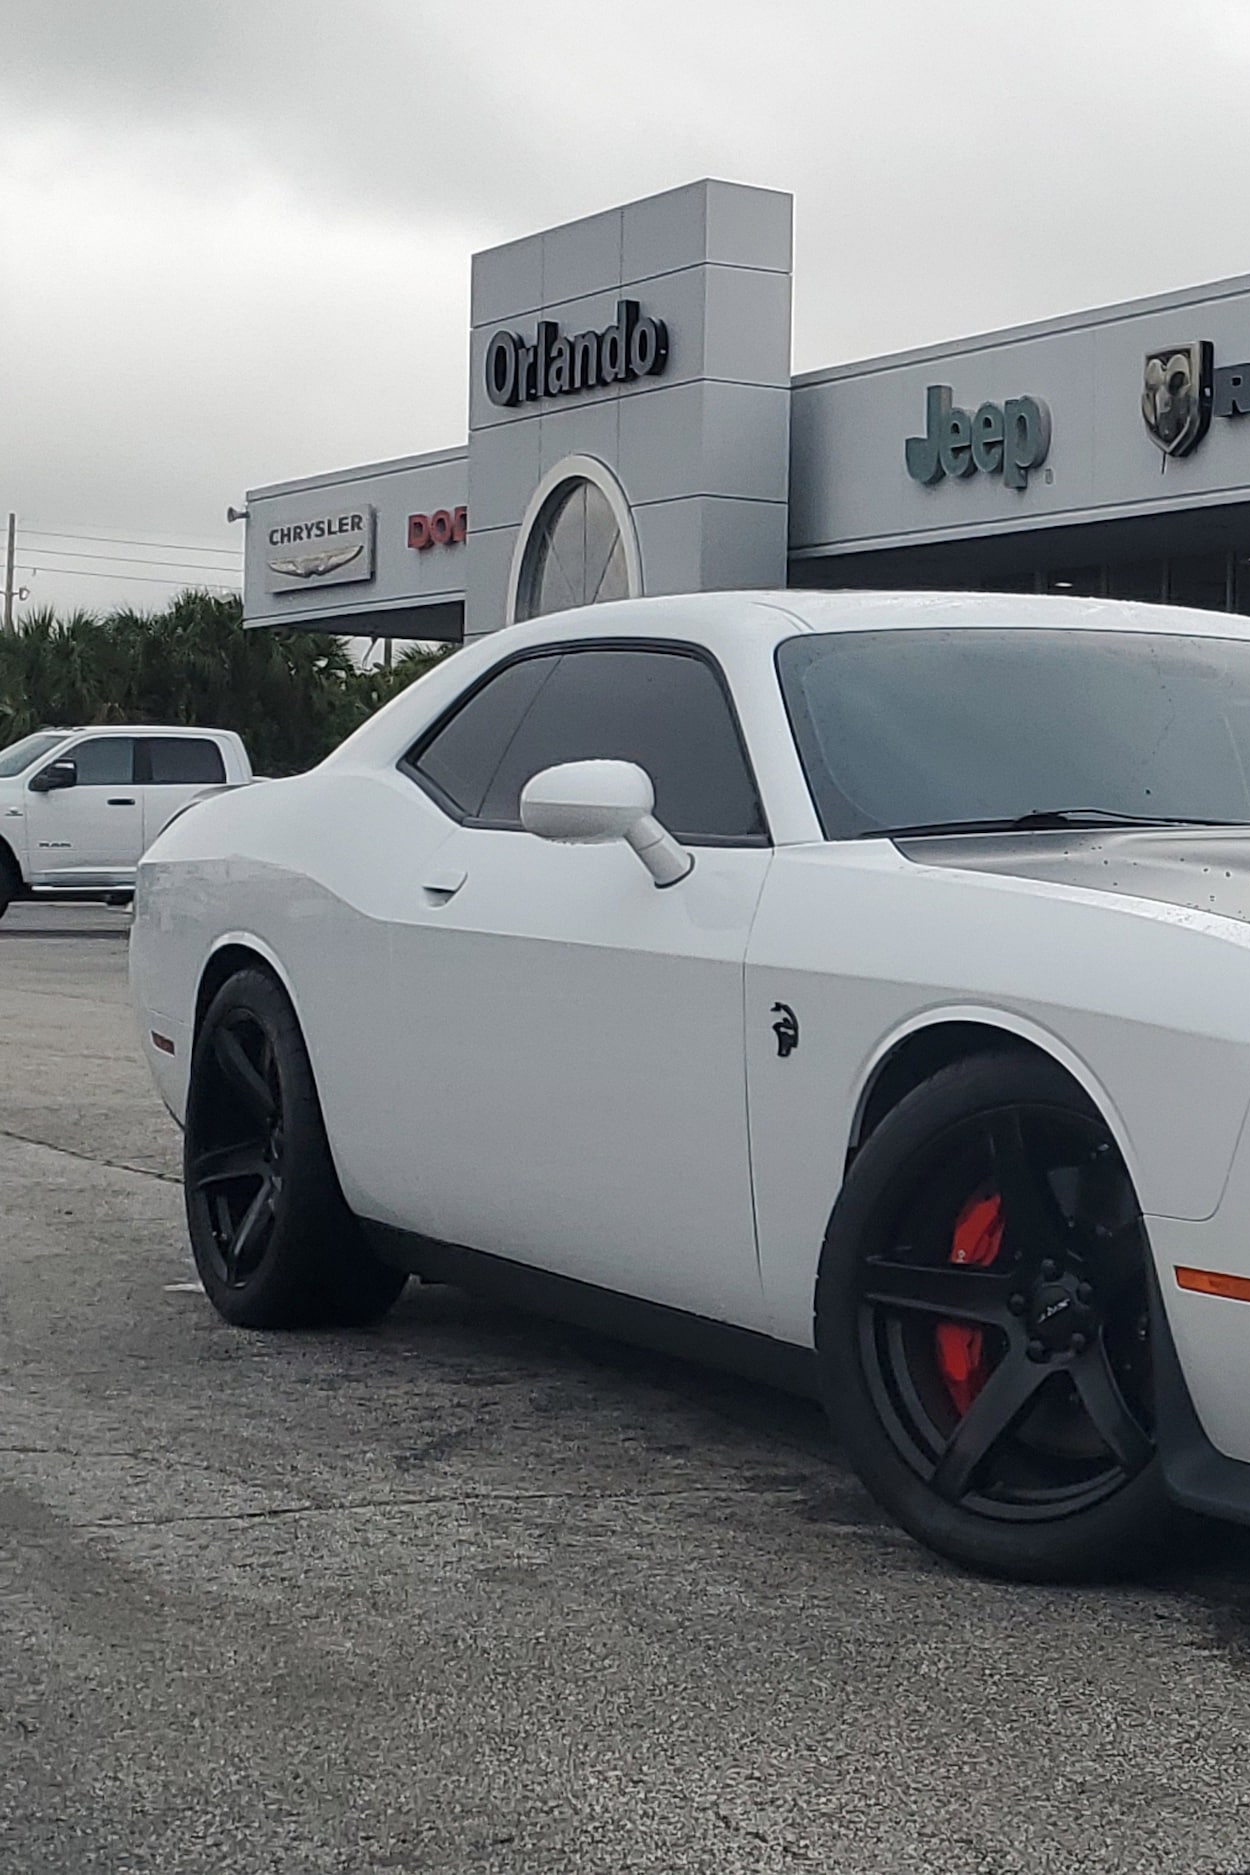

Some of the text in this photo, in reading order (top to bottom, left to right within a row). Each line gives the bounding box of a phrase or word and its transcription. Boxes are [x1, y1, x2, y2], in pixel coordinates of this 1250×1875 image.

[486, 299, 668, 407] Orlando
[905, 385, 1051, 488] Jeep
[269, 514, 363, 546] CHRYSLER
